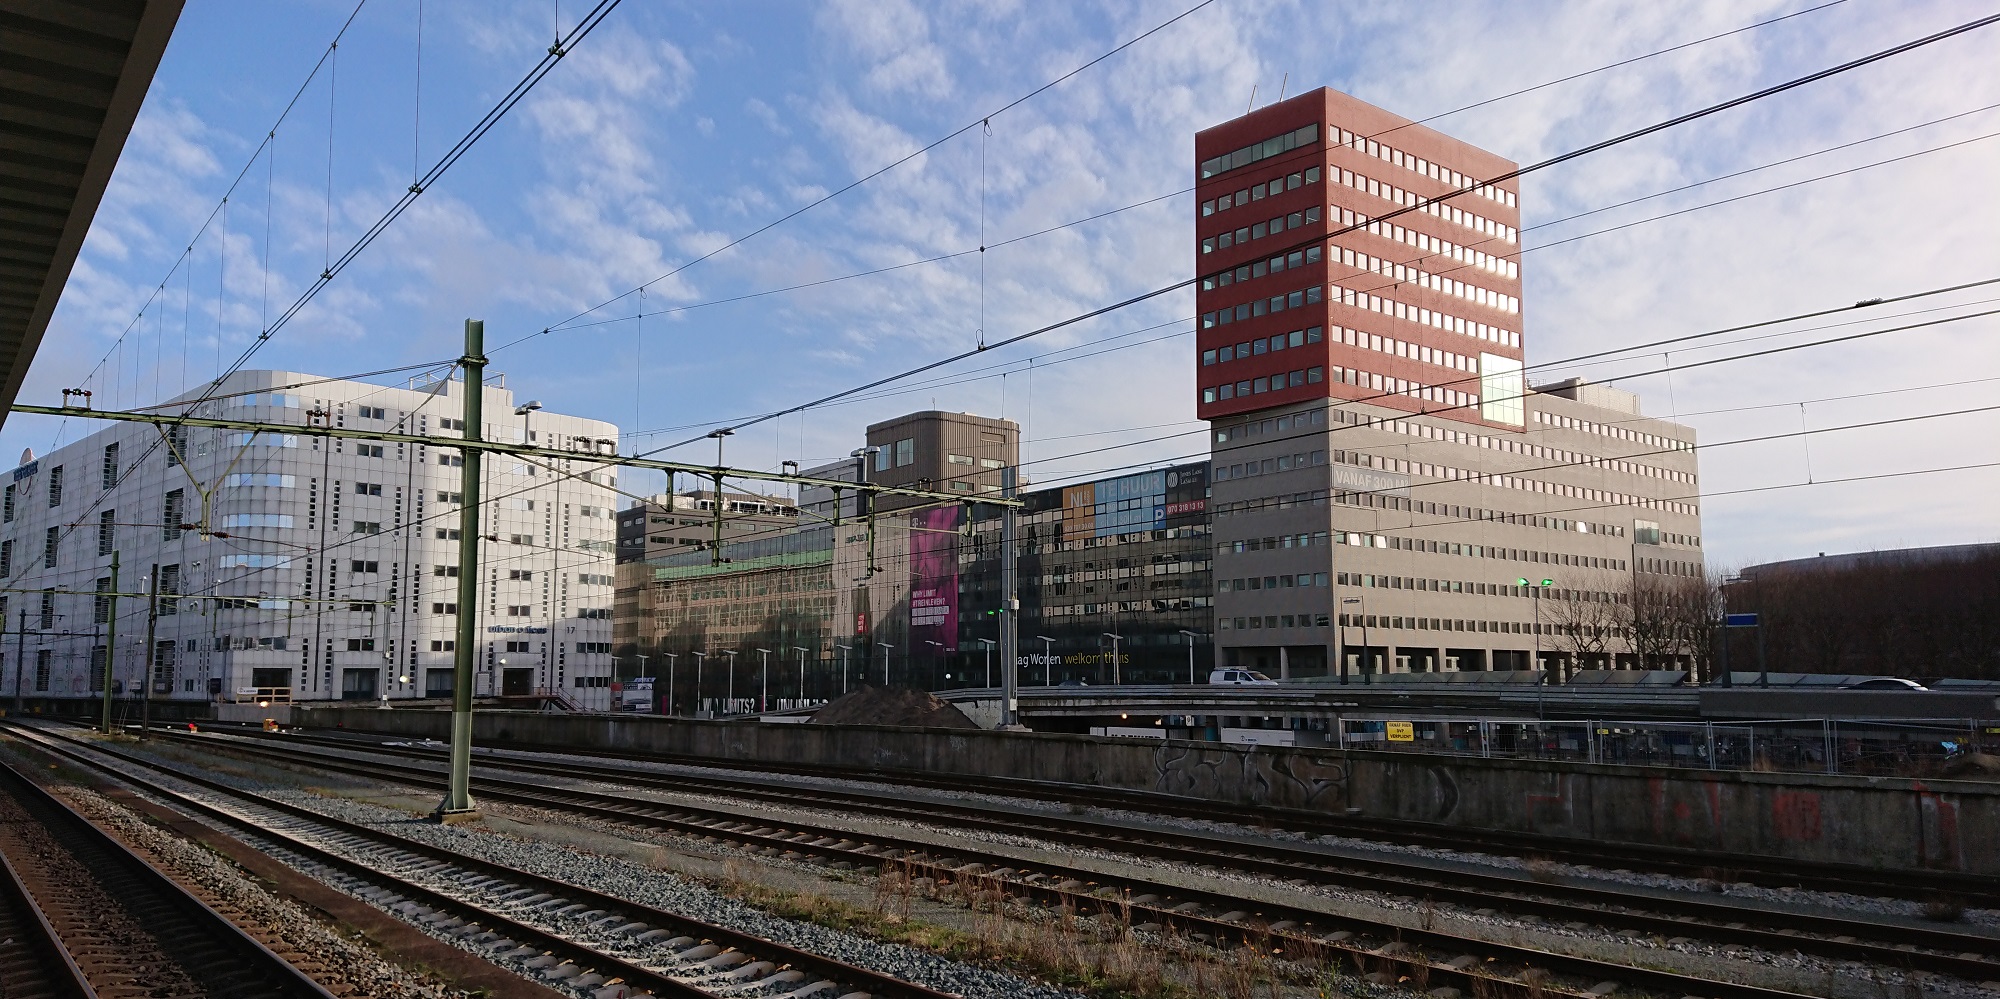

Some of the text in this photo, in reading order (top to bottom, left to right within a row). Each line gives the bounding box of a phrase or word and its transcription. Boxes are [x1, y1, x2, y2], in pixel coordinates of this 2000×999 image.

[1100, 481, 1117, 499] TE
[1119, 474, 1161, 495] HUUR
[1335, 470, 1372, 487] VANAF
[1373, 476, 1393, 489] 300
[1167, 501, 1204, 513] 070 318 13 13
[566, 626, 576, 635] 17
